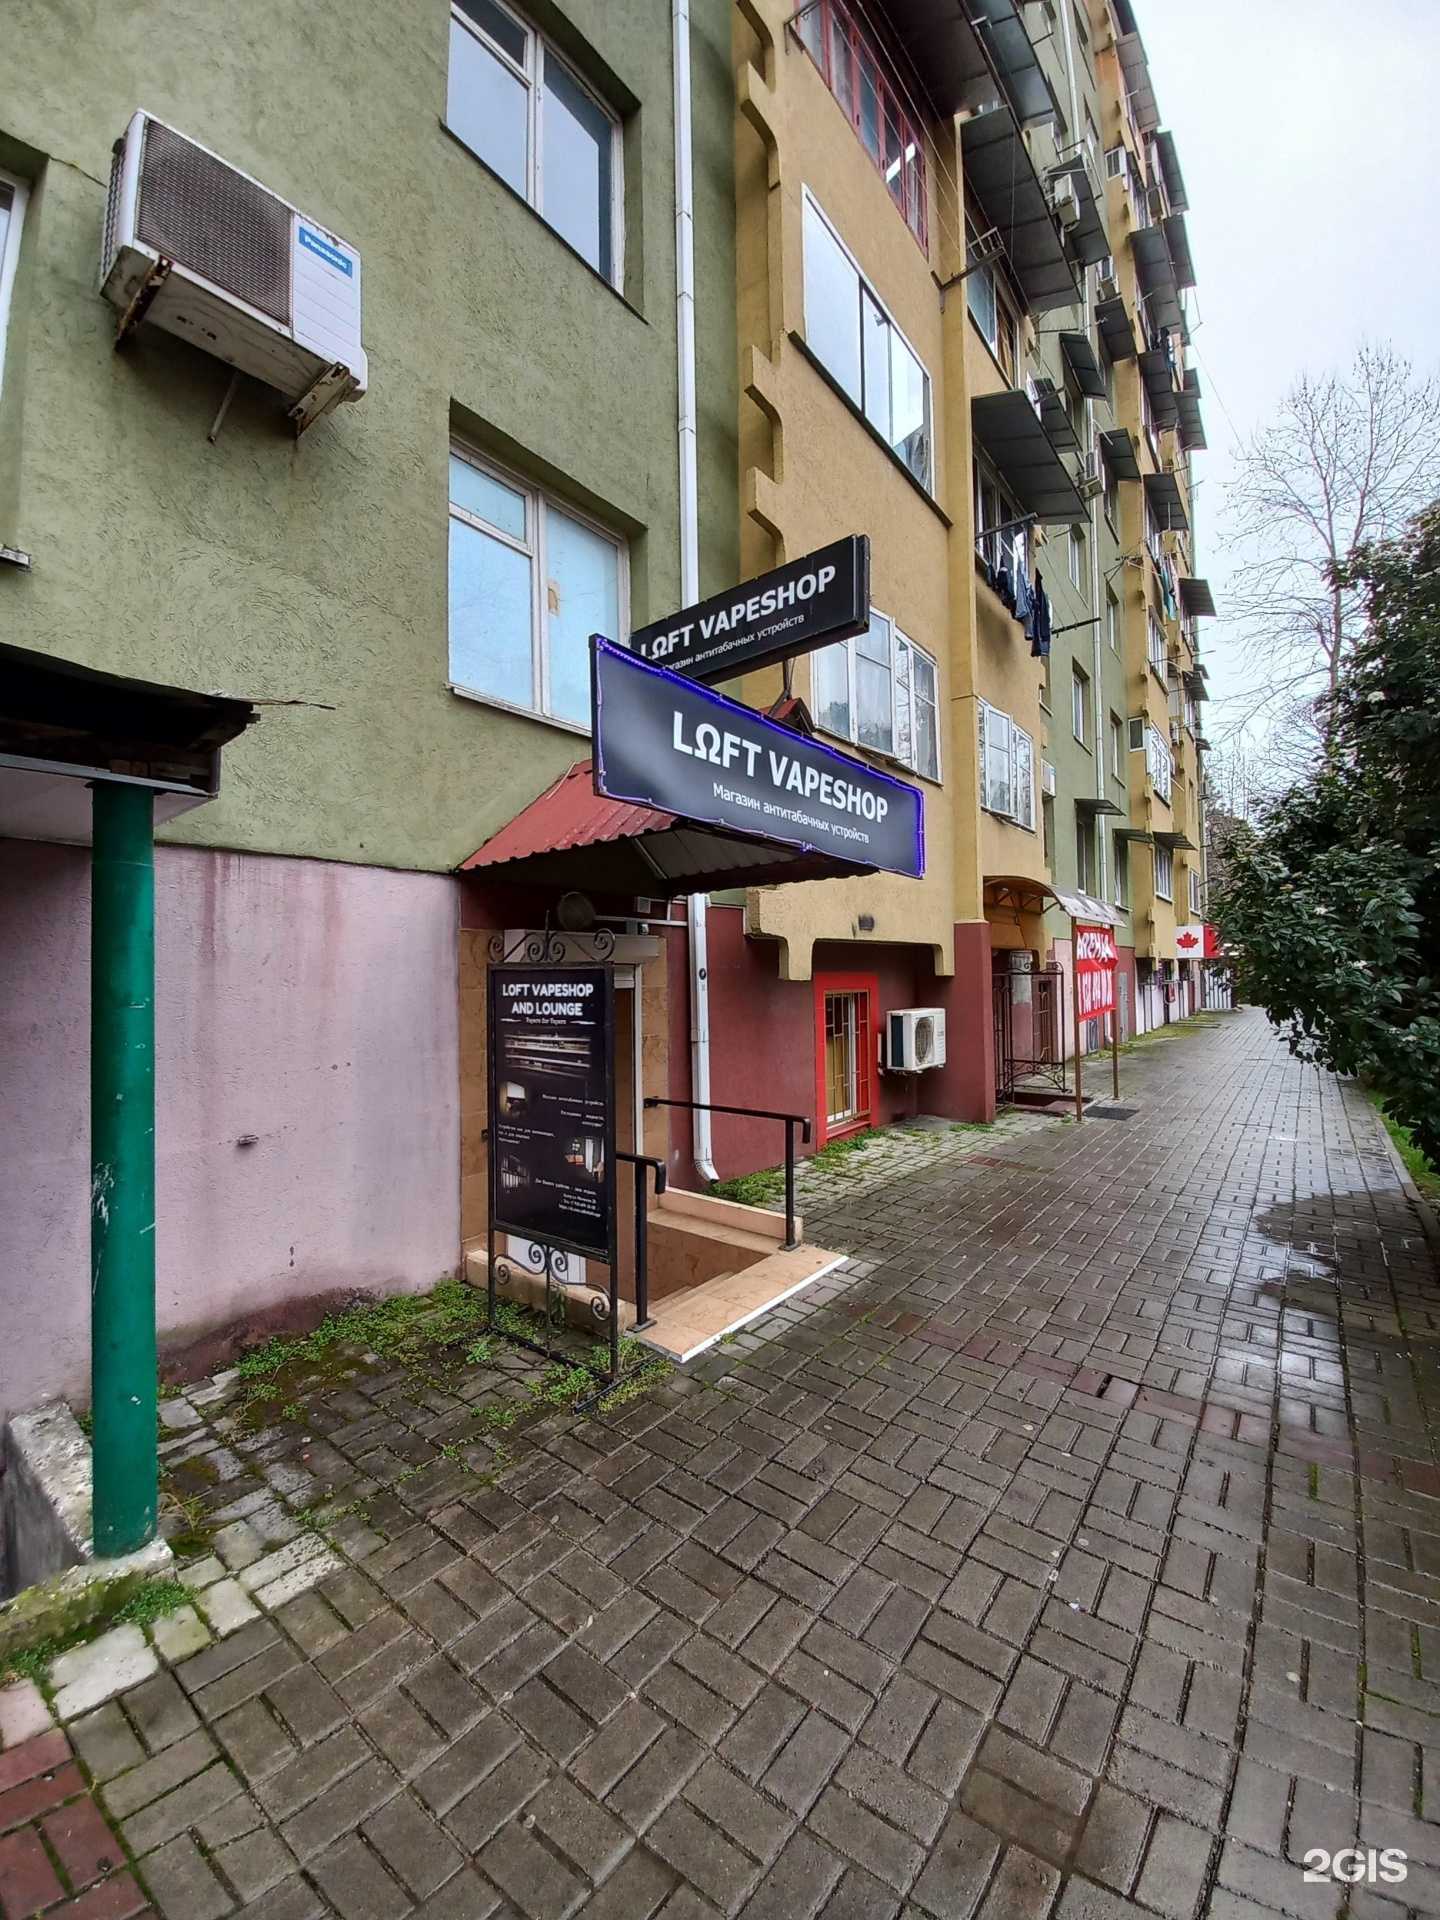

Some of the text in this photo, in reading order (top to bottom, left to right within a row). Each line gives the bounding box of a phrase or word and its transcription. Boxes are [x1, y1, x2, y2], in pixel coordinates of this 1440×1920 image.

[699, 565, 836, 639] VAPESHOP
[695, 633, 755, 662] антитабачных
[757, 614, 805, 641] устройств
[713, 782, 870, 844] Магазин антитабачных устройств
[769, 750, 888, 823] VAPESHOP
[502, 983, 594, 998] LOFT VAPESHOP
[511, 1002, 584, 1016] AND LOUNGE
